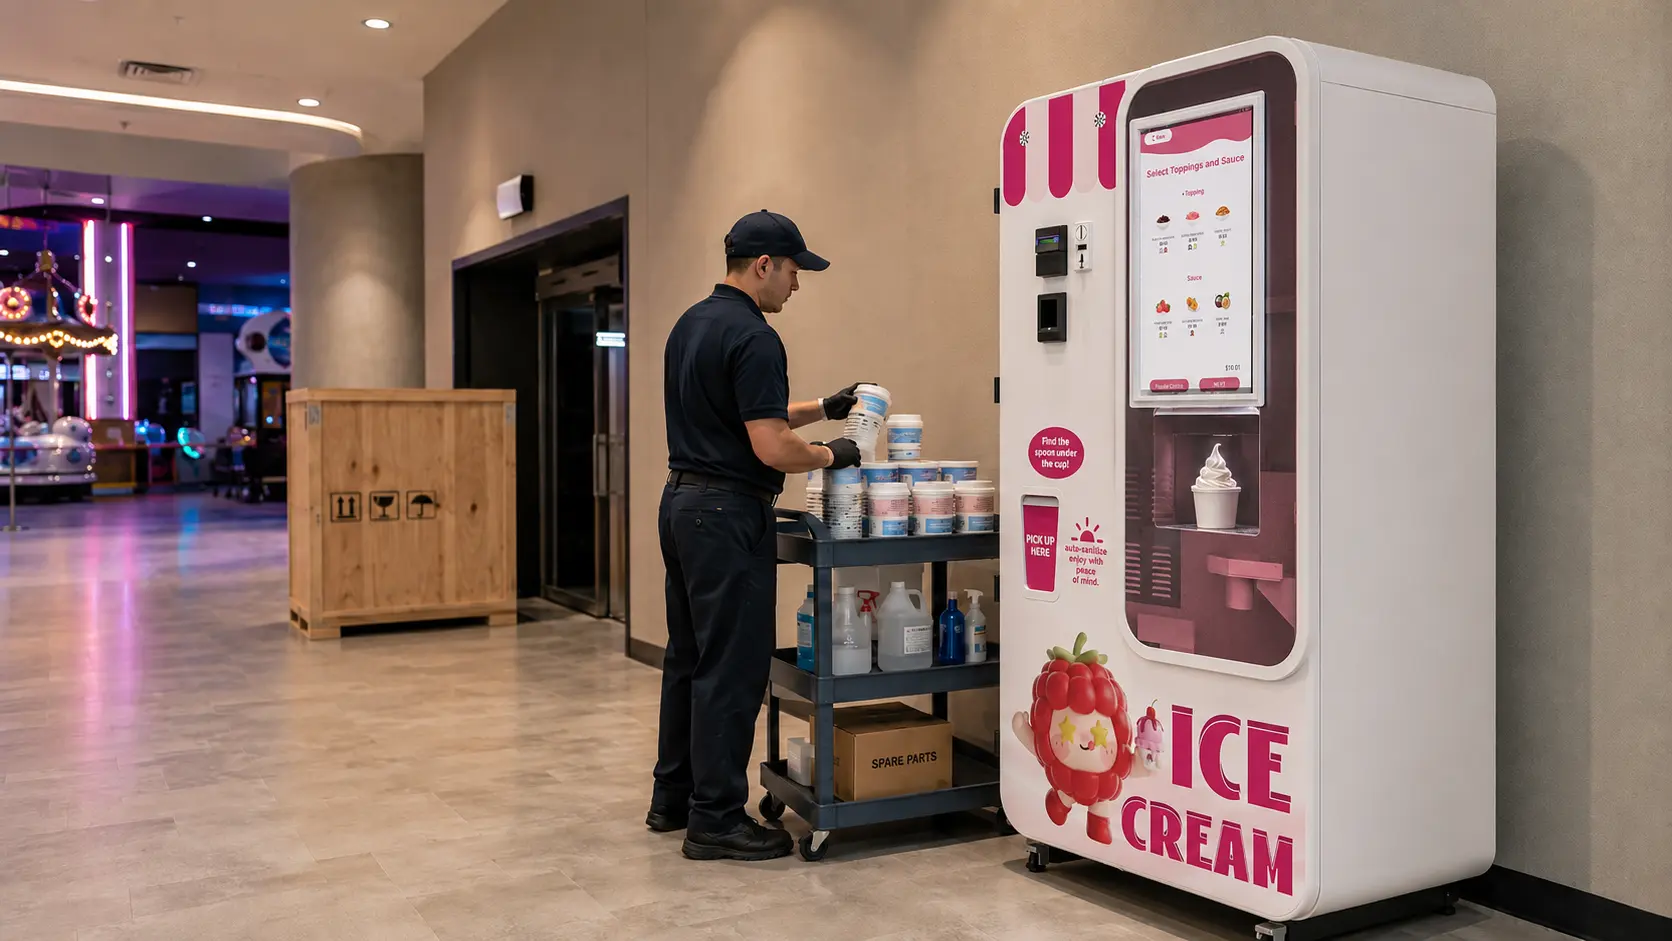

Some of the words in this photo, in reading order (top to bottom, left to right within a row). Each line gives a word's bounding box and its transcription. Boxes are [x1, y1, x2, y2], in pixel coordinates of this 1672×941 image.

[1147, 168, 1169, 178] Select
[1170, 162, 1203, 175] Toppings
[1205, 158, 1219, 168] and
[1221, 154, 1245, 165] Sauce
[1185, 188, 1204, 197] Topping
[1042, 437, 1057, 446] Find
[1058, 437, 1070, 446] the
[1035, 449, 1055, 460] spoon
[1056, 449, 1077, 457] under
[1042, 460, 1053, 468] the
[1054, 460, 1070, 471] cup!
[1026, 534, 1043, 545] PICK
[1044, 536, 1055, 546] UP
[1030, 546, 1050, 557] HERE
[1065, 544, 1107, 556] auto-sanitize
[1069, 556, 1087, 566] enjoy
[1088, 556, 1104, 565] with
[1076, 567, 1096, 576] peace
[1072, 576, 1080, 584] of
[1080, 576, 1099, 586] mind.
[871, 755, 904, 769] SPARE
[906, 751, 937, 765] PARTS
[1171, 704, 1292, 814] ICE
[1120, 795, 1294, 897] CREAM
